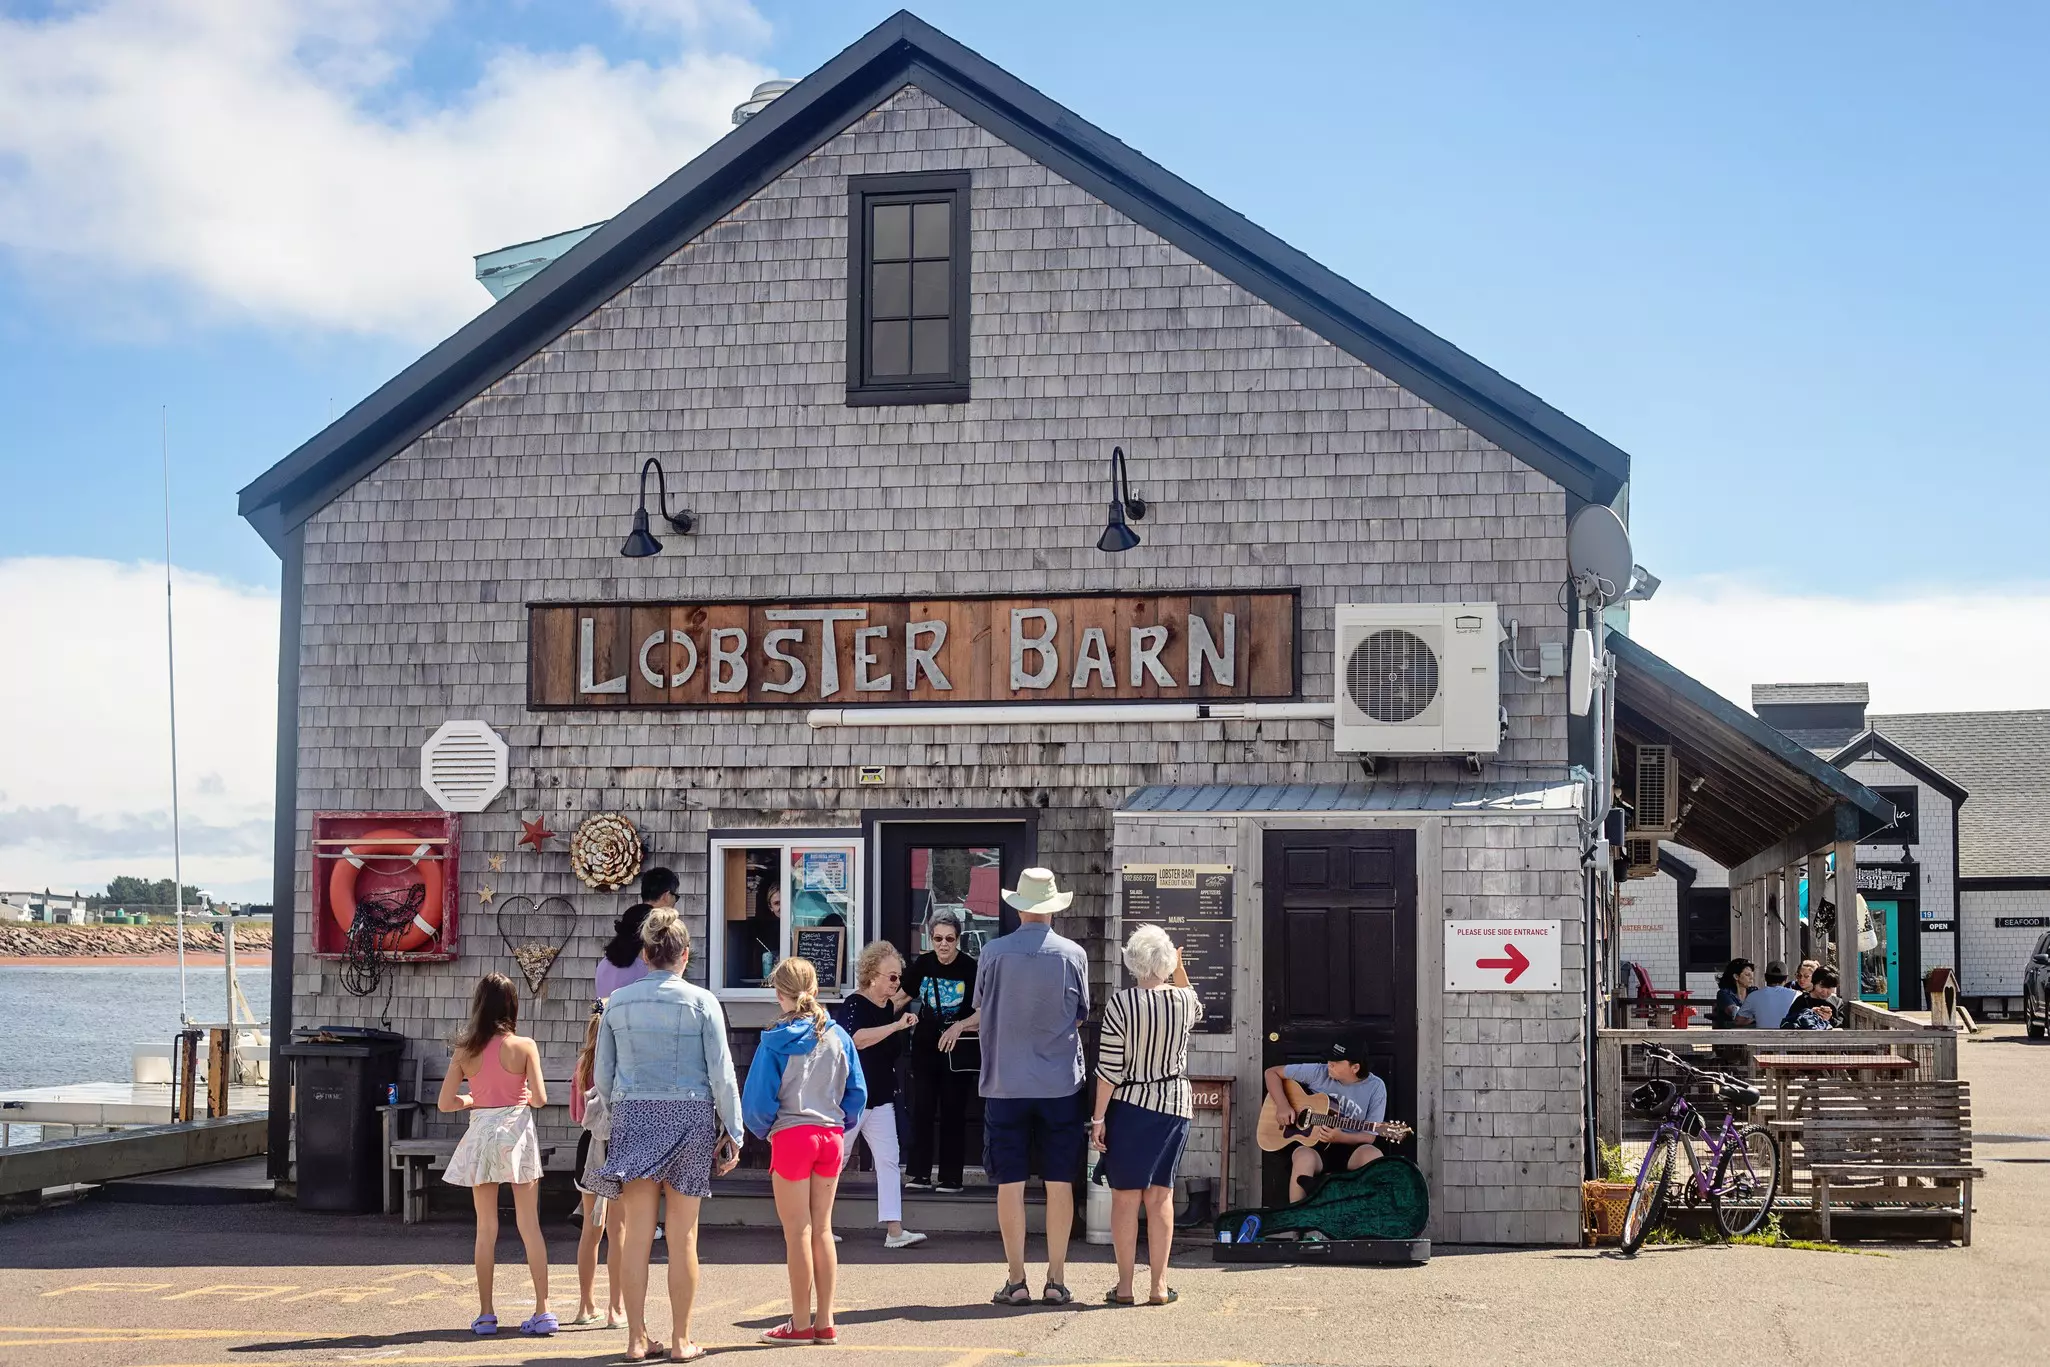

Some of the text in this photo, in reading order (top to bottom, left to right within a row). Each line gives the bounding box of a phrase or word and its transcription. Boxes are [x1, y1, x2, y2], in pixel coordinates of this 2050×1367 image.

[580, 608, 1236, 698] LOBSTER BARN
[1160, 869, 1195, 879] LOBSTER BARN
